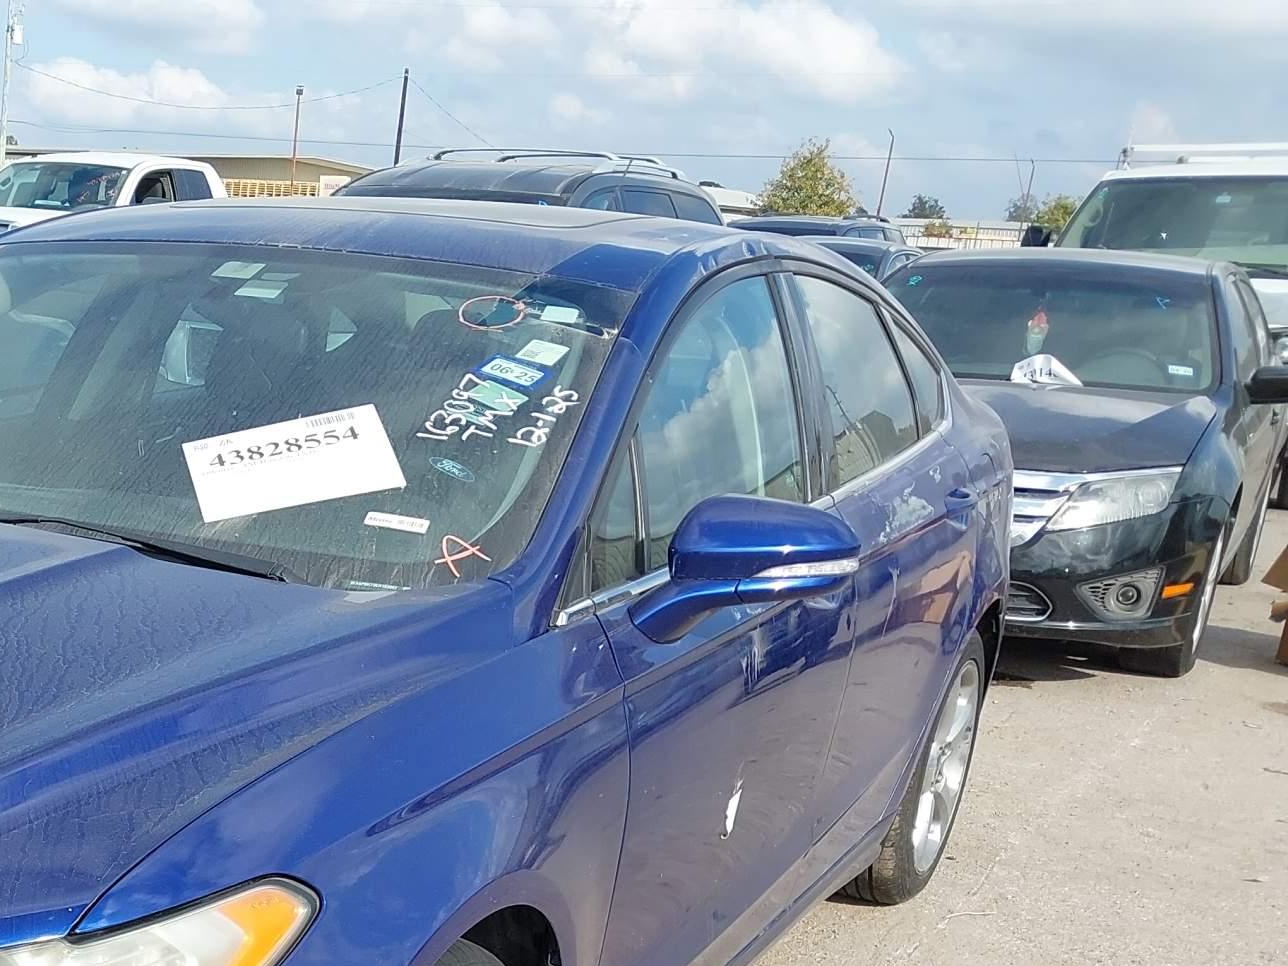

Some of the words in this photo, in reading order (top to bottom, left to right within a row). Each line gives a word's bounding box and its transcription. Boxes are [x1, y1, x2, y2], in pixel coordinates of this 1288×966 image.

[513, 371, 537, 383] 25
[462, 391, 518, 441] TMX
[208, 425, 360, 468] 43828554
[437, 458, 468, 478] Ford
